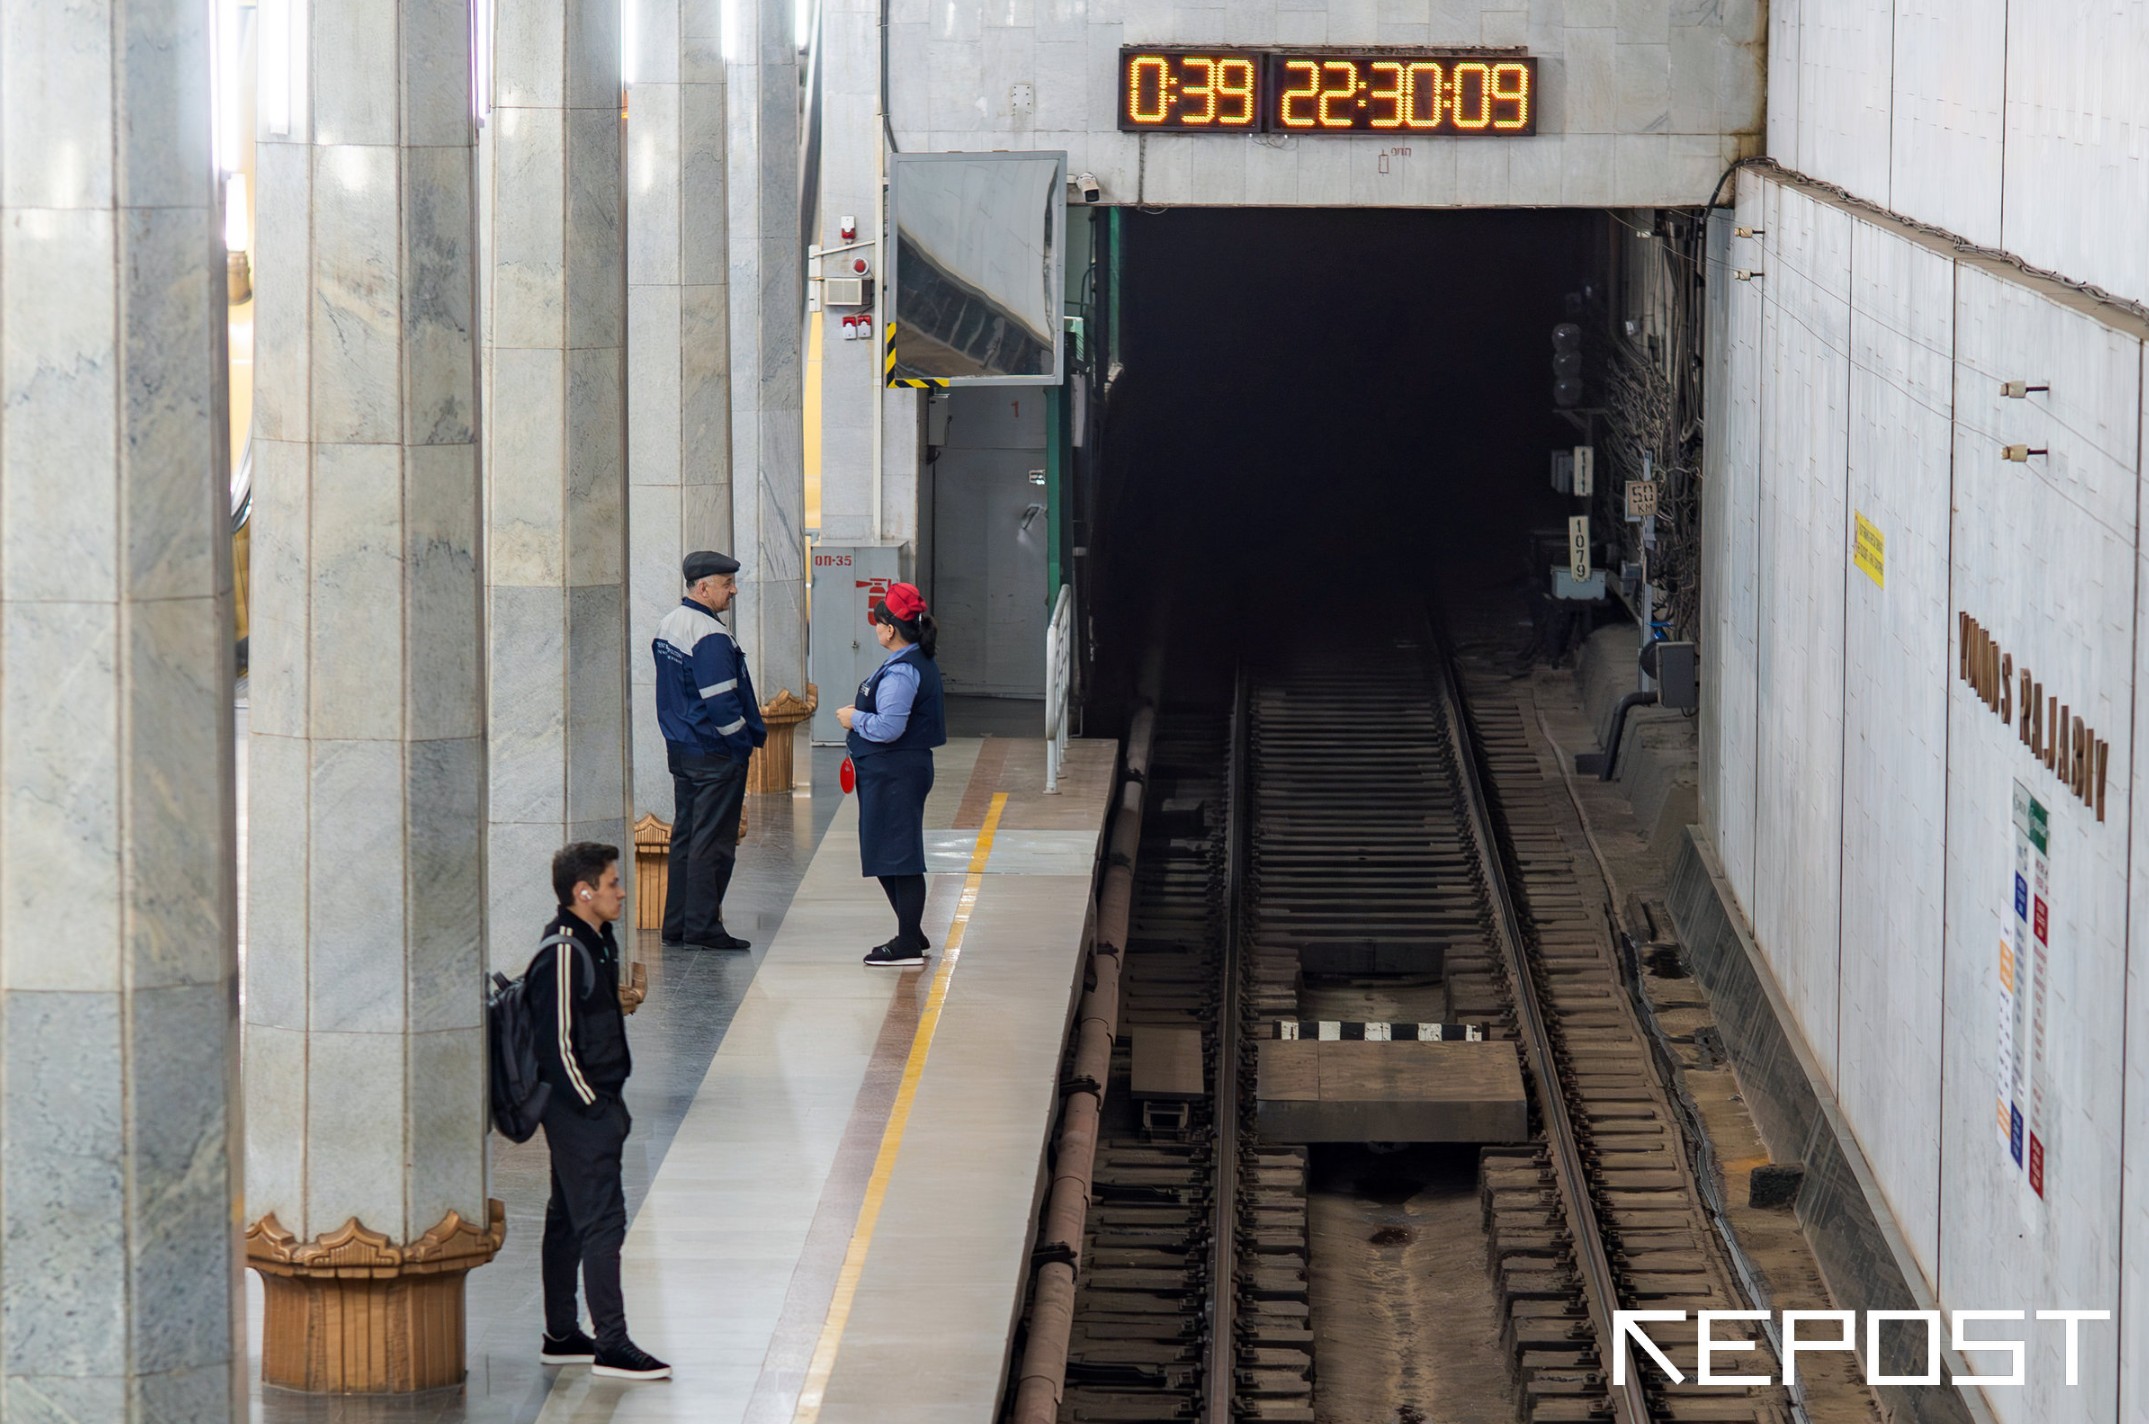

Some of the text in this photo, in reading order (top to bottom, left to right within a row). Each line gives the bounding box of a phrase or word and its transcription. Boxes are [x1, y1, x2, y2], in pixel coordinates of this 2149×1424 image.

[1130, 56, 1254, 124] 0:39
[1281, 59, 1529, 129] 22:30:09
[815, 555, 852, 566] ОП-35
[1575, 519, 1586, 578] 1079
[2019, 667, 2109, 823] RAJABIY
